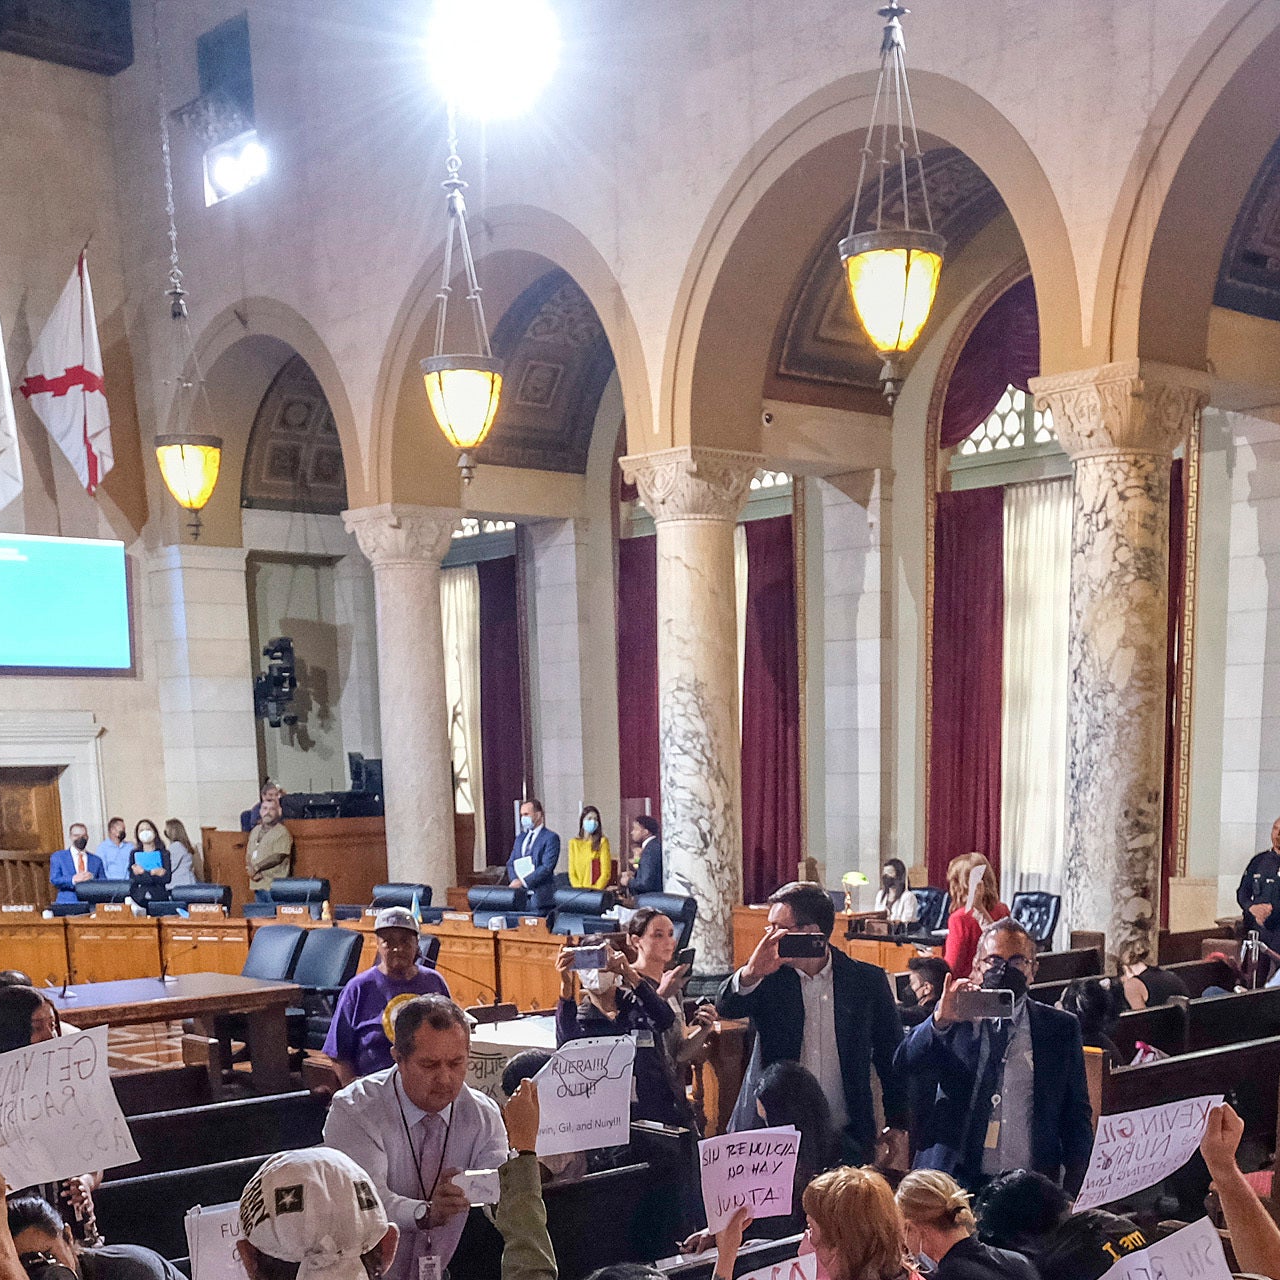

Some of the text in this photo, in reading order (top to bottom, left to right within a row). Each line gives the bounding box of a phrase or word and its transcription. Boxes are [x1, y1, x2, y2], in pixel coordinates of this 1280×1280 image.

[576, 1120, 593, 1131] and
[702, 1142, 796, 1167] SIN RENUNCIA
[727, 1160, 783, 1181] NO HAY
[715, 1187, 780, 1217] JUNTA
